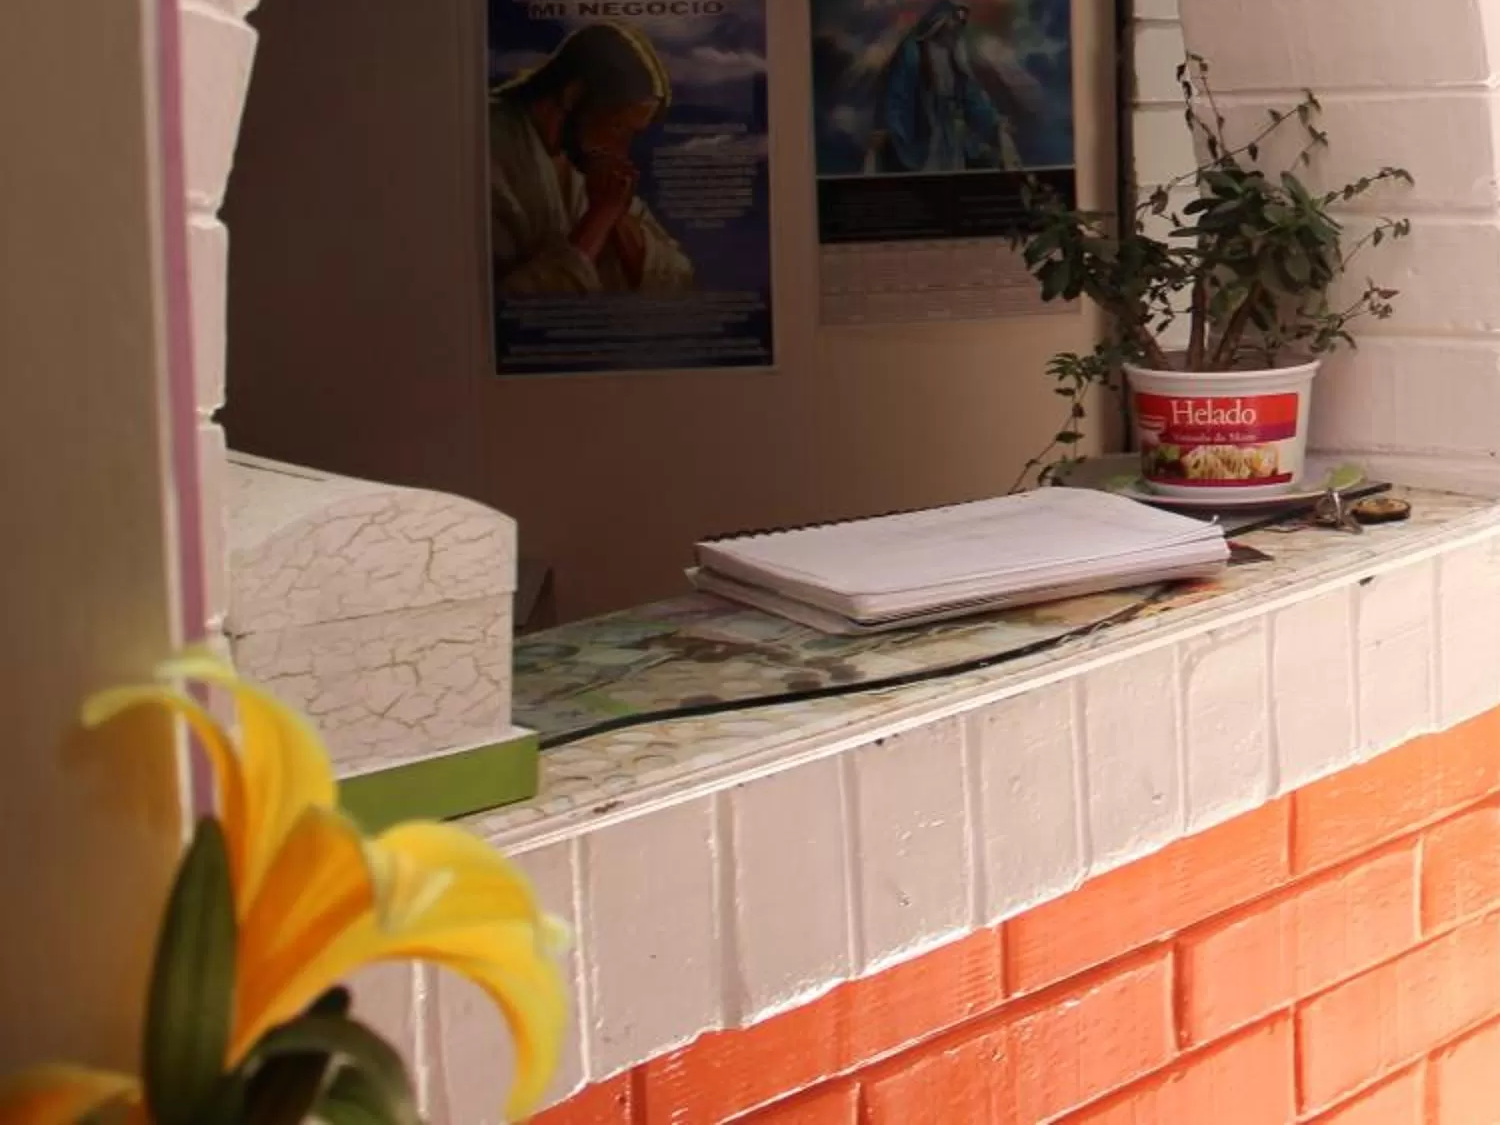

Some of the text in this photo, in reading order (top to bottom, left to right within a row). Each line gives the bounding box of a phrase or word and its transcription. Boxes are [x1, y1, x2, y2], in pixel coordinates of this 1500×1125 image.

[529, 1, 725, 18] MI NEGOCIO
[1170, 399, 1257, 425] Helado
